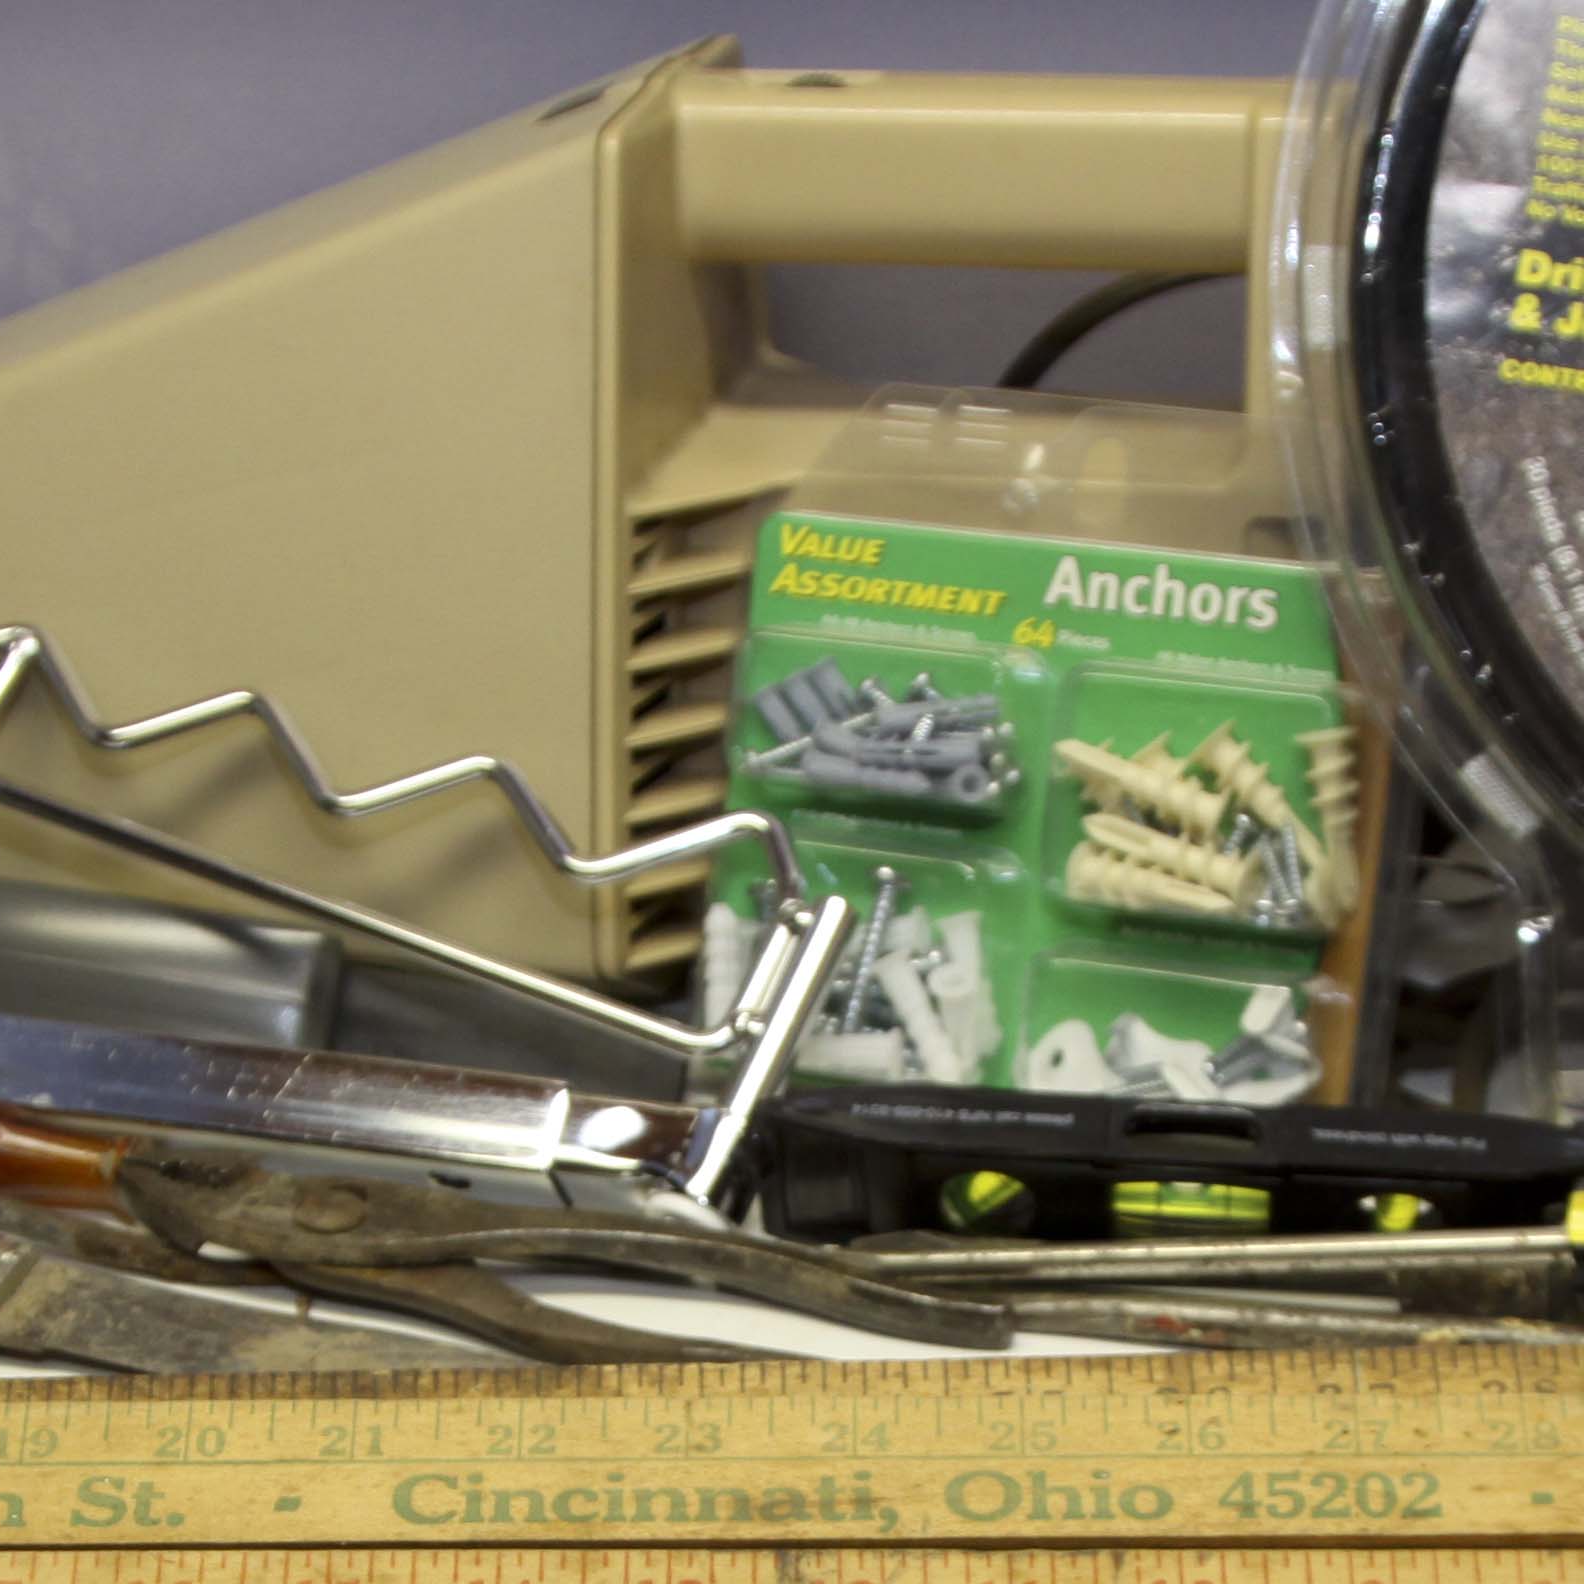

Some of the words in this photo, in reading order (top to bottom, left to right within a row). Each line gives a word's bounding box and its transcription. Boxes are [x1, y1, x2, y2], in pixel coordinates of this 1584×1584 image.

[1511, 293, 1542, 332] &
[778, 524, 885, 564] VALUE
[770, 564, 1006, 616] ASSORTMENT
[1044, 556, 1277, 628] Anchors
[1014, 618, 1054, 648] 64
[155, 1428, 226, 1457] 20
[319, 1427, 383, 1457] 21
[487, 1425, 557, 1454] 22
[654, 1424, 722, 1453] 23
[821, 1424, 903, 1452] 24
[989, 1422, 1057, 1451] 25
[1155, 1422, 1226, 1450] 26
[1323, 1420, 1391, 1450] 27
[1488, 1419, 1560, 1450] 28
[69, 1475, 186, 1527] St.
[392, 1470, 900, 1533] Cincinnati,
[944, 1469, 1174, 1521] Ohio
[1218, 1470, 1444, 1520] 45202
